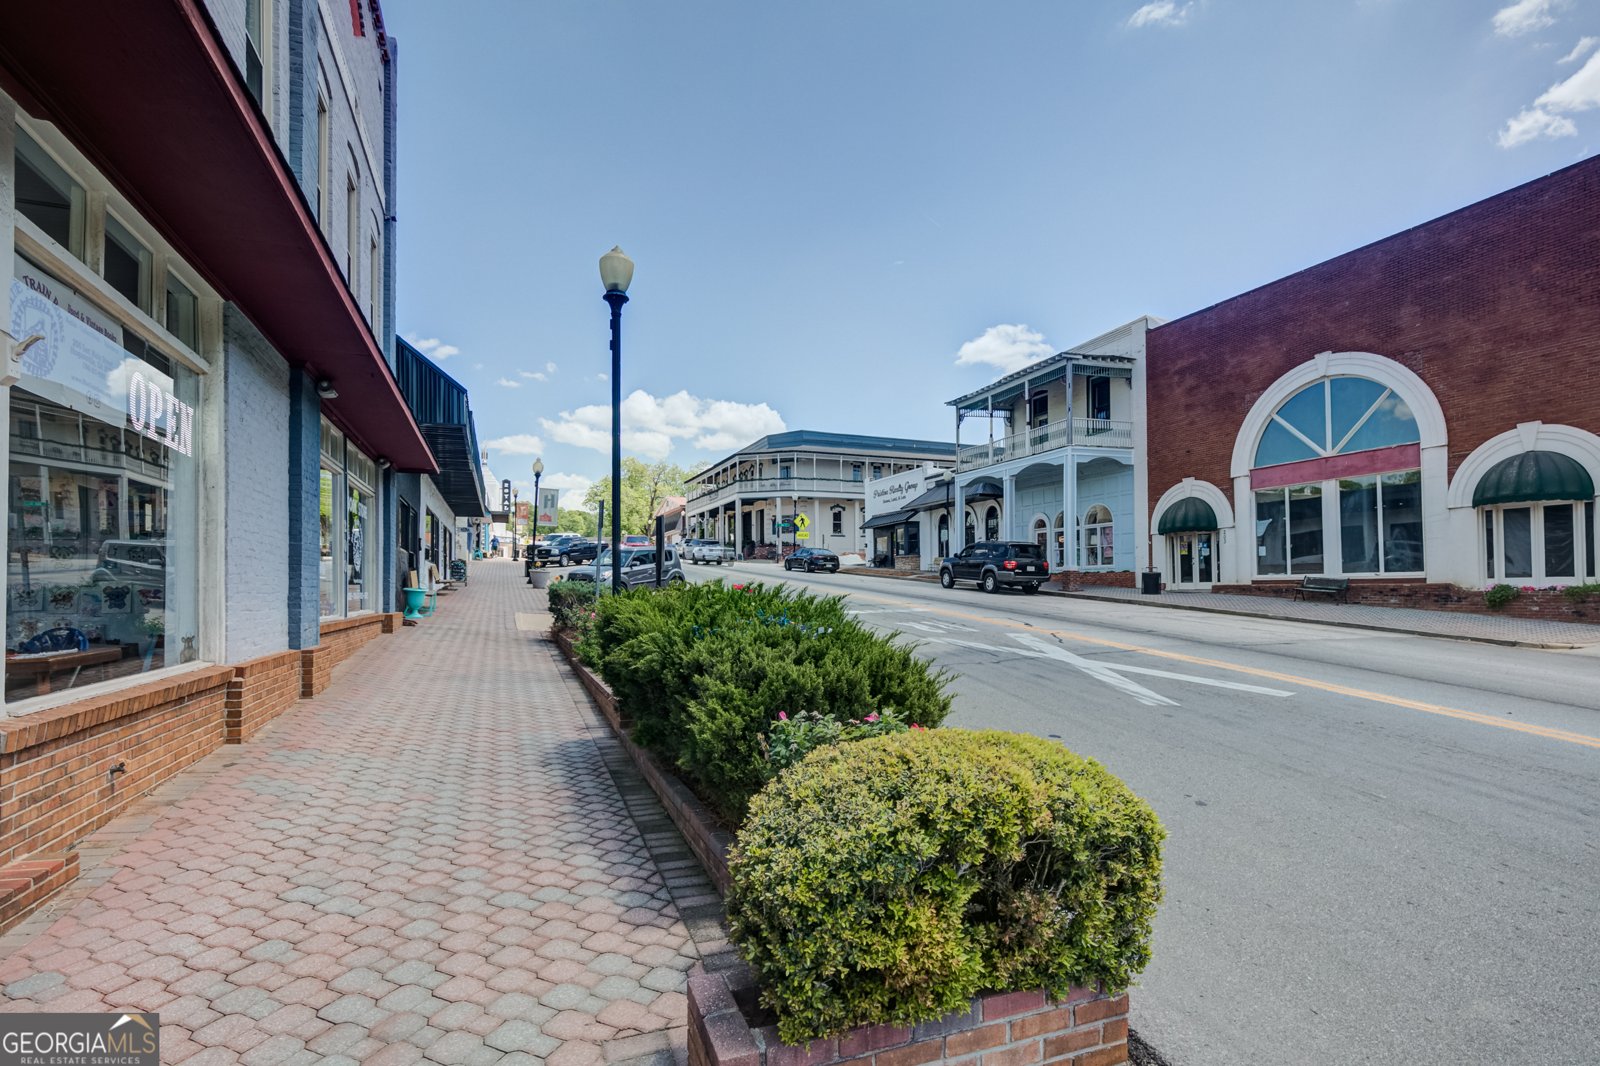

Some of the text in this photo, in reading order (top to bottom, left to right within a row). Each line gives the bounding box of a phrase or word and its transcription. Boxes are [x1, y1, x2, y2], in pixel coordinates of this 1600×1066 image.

[22, 275, 52, 299] TRAIN
[129, 371, 194, 457] OPEN
[904, 481, 918, 493] Group
